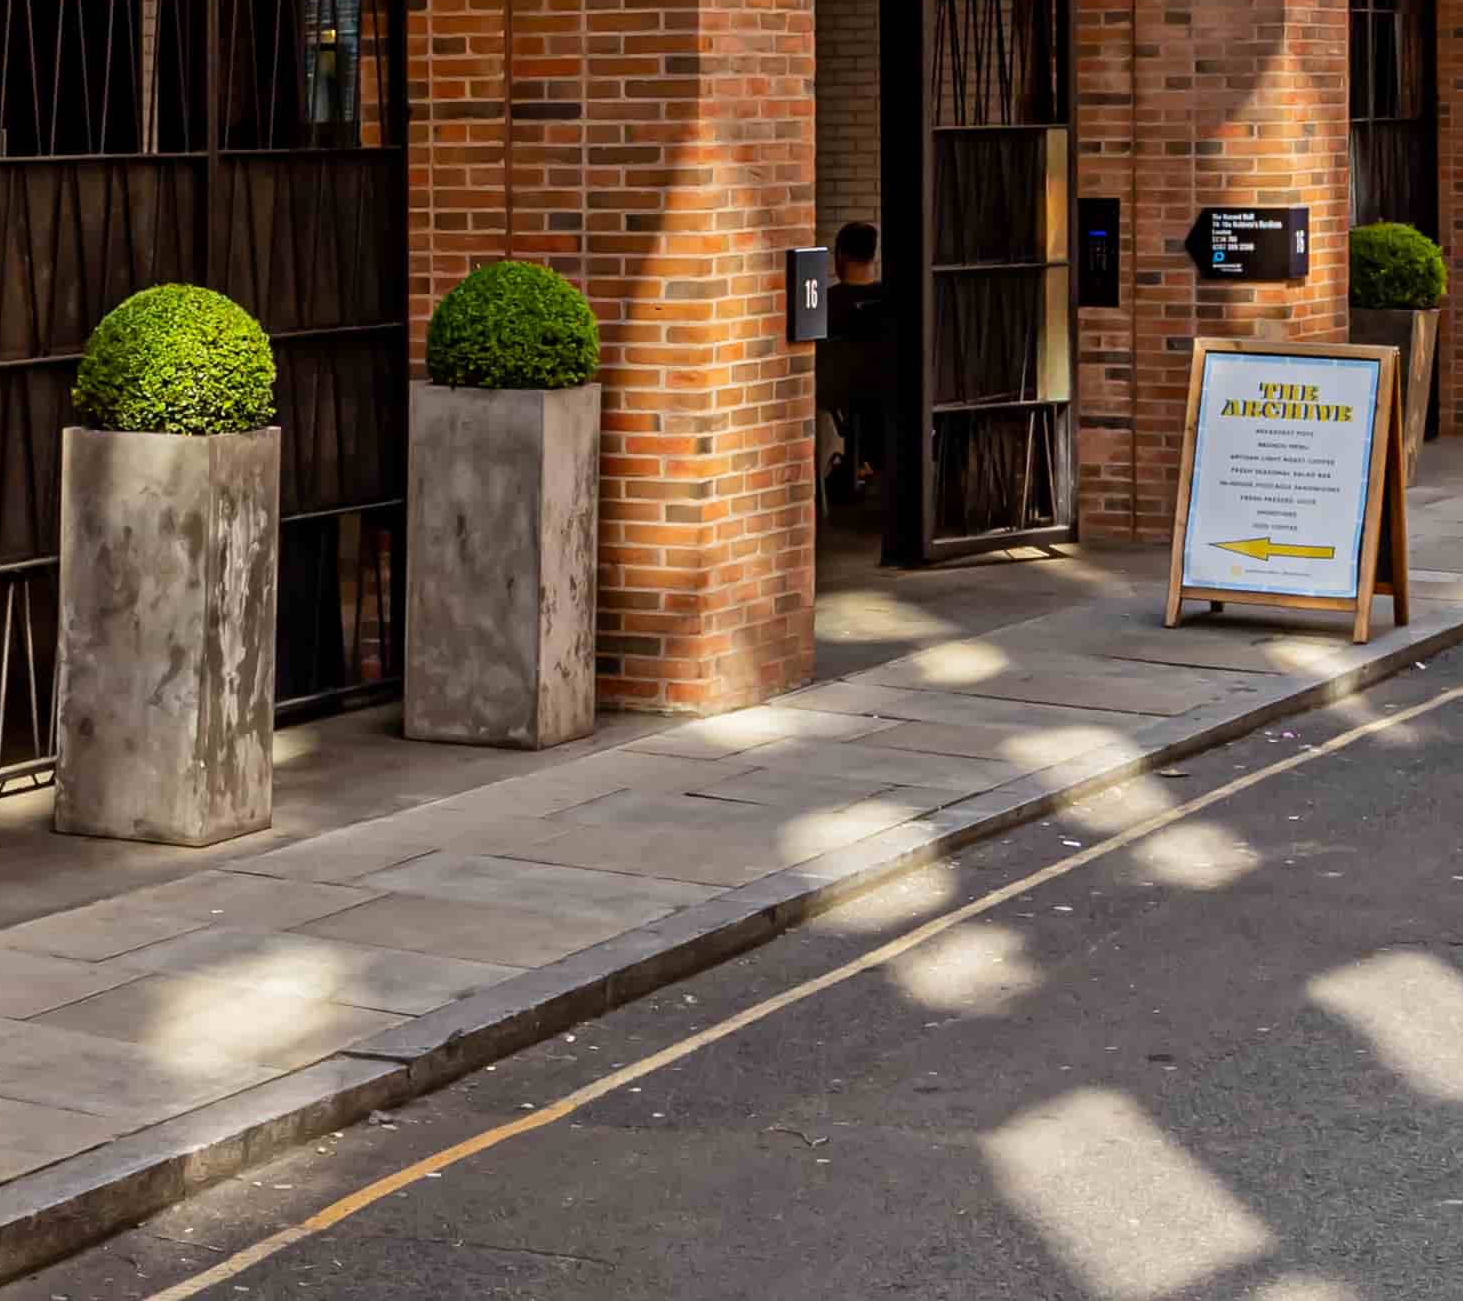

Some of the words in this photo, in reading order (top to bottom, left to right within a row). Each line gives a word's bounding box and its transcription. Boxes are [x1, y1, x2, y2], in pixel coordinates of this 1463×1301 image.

[805, 279, 818, 309] 16
[1258, 382, 1319, 401] THE
[1221, 399, 1353, 422] ARCHIVE
